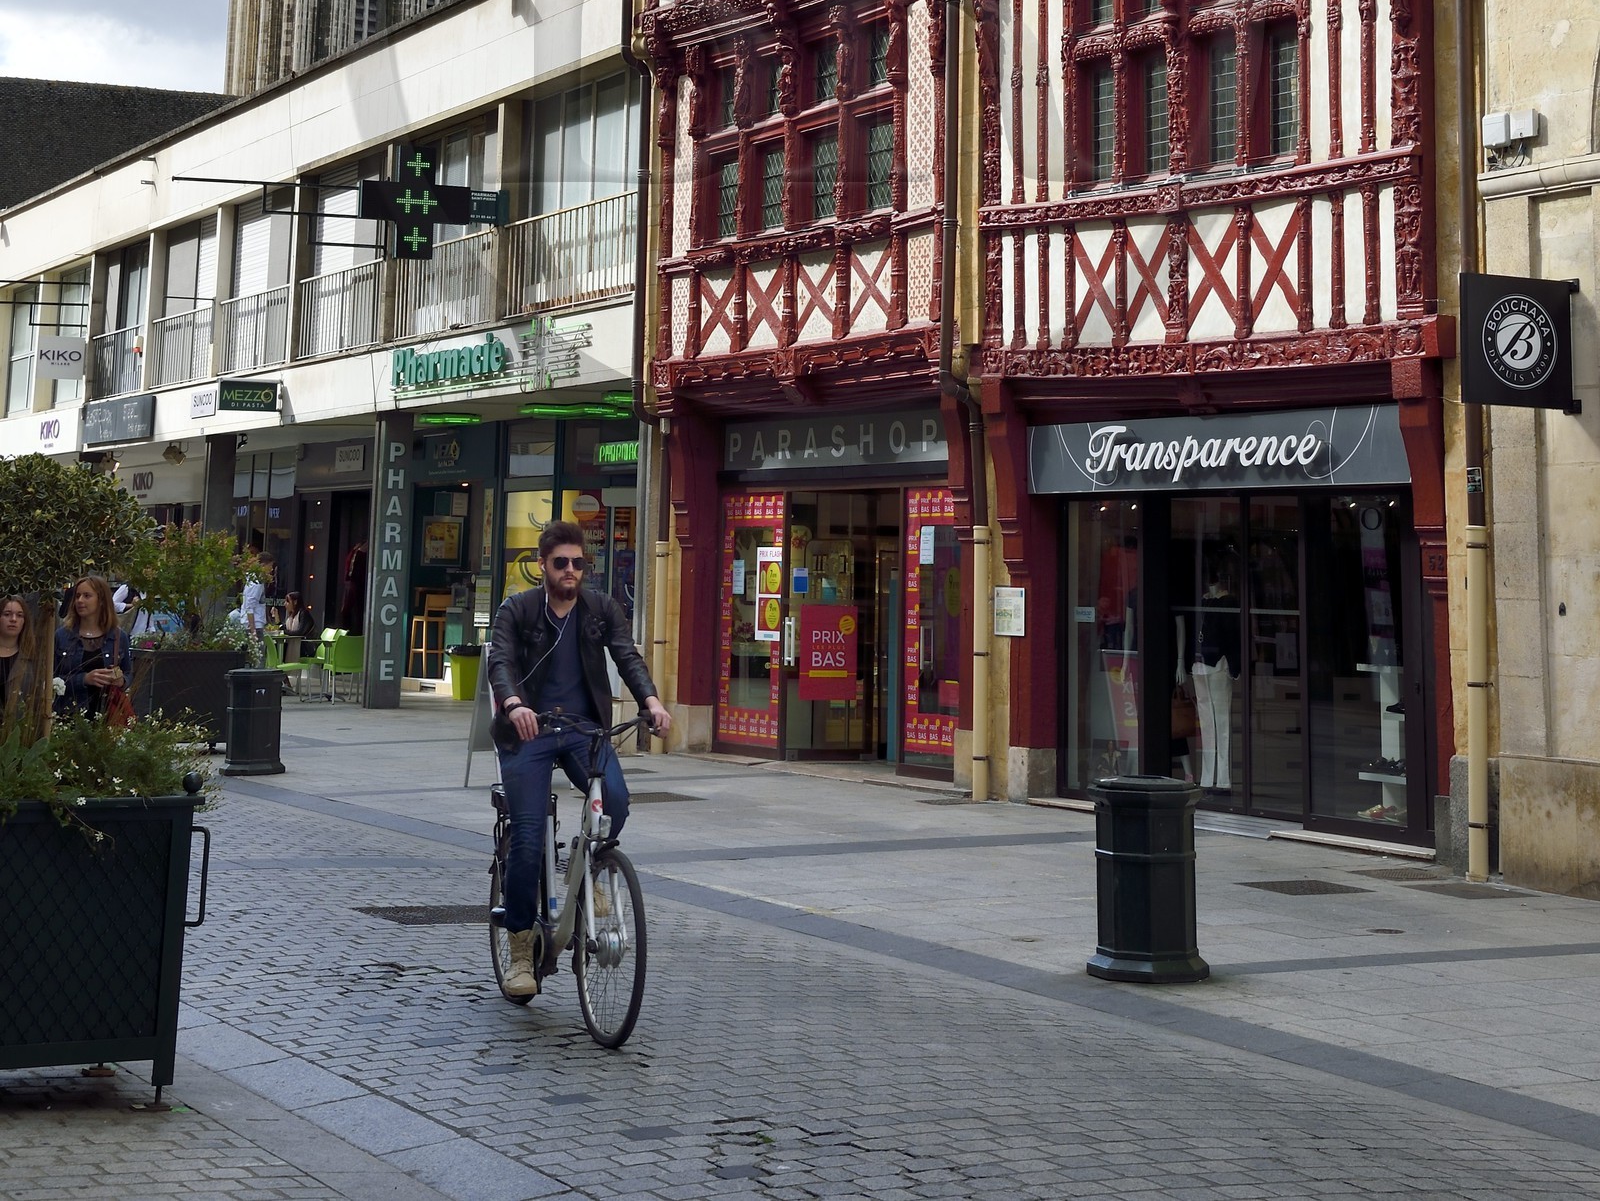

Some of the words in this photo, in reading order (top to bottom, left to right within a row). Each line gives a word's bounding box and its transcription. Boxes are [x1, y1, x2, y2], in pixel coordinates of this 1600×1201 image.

[1487, 300, 1551, 337] BOUCHARA
[40, 349, 82, 362] KIKO
[392, 333, 505, 386] Pharmacie
[1488, 349, 1525, 382] DEPUIS
[1530, 353, 1549, 379] 1899
[222, 387, 274, 403] MEZZO
[40, 419, 60, 440] KIKO
[730, 419, 938, 462] PARASHOP
[599, 442, 639, 462] PHARMAC
[1085, 425, 1322, 483] Transparence
[132, 472, 154, 491] KIKO
[379, 442, 406, 682] PHARMACIE
[759, 550, 769, 558] PRIX
[812, 630, 845, 644] PRIX
[811, 651, 846, 667] BAS
